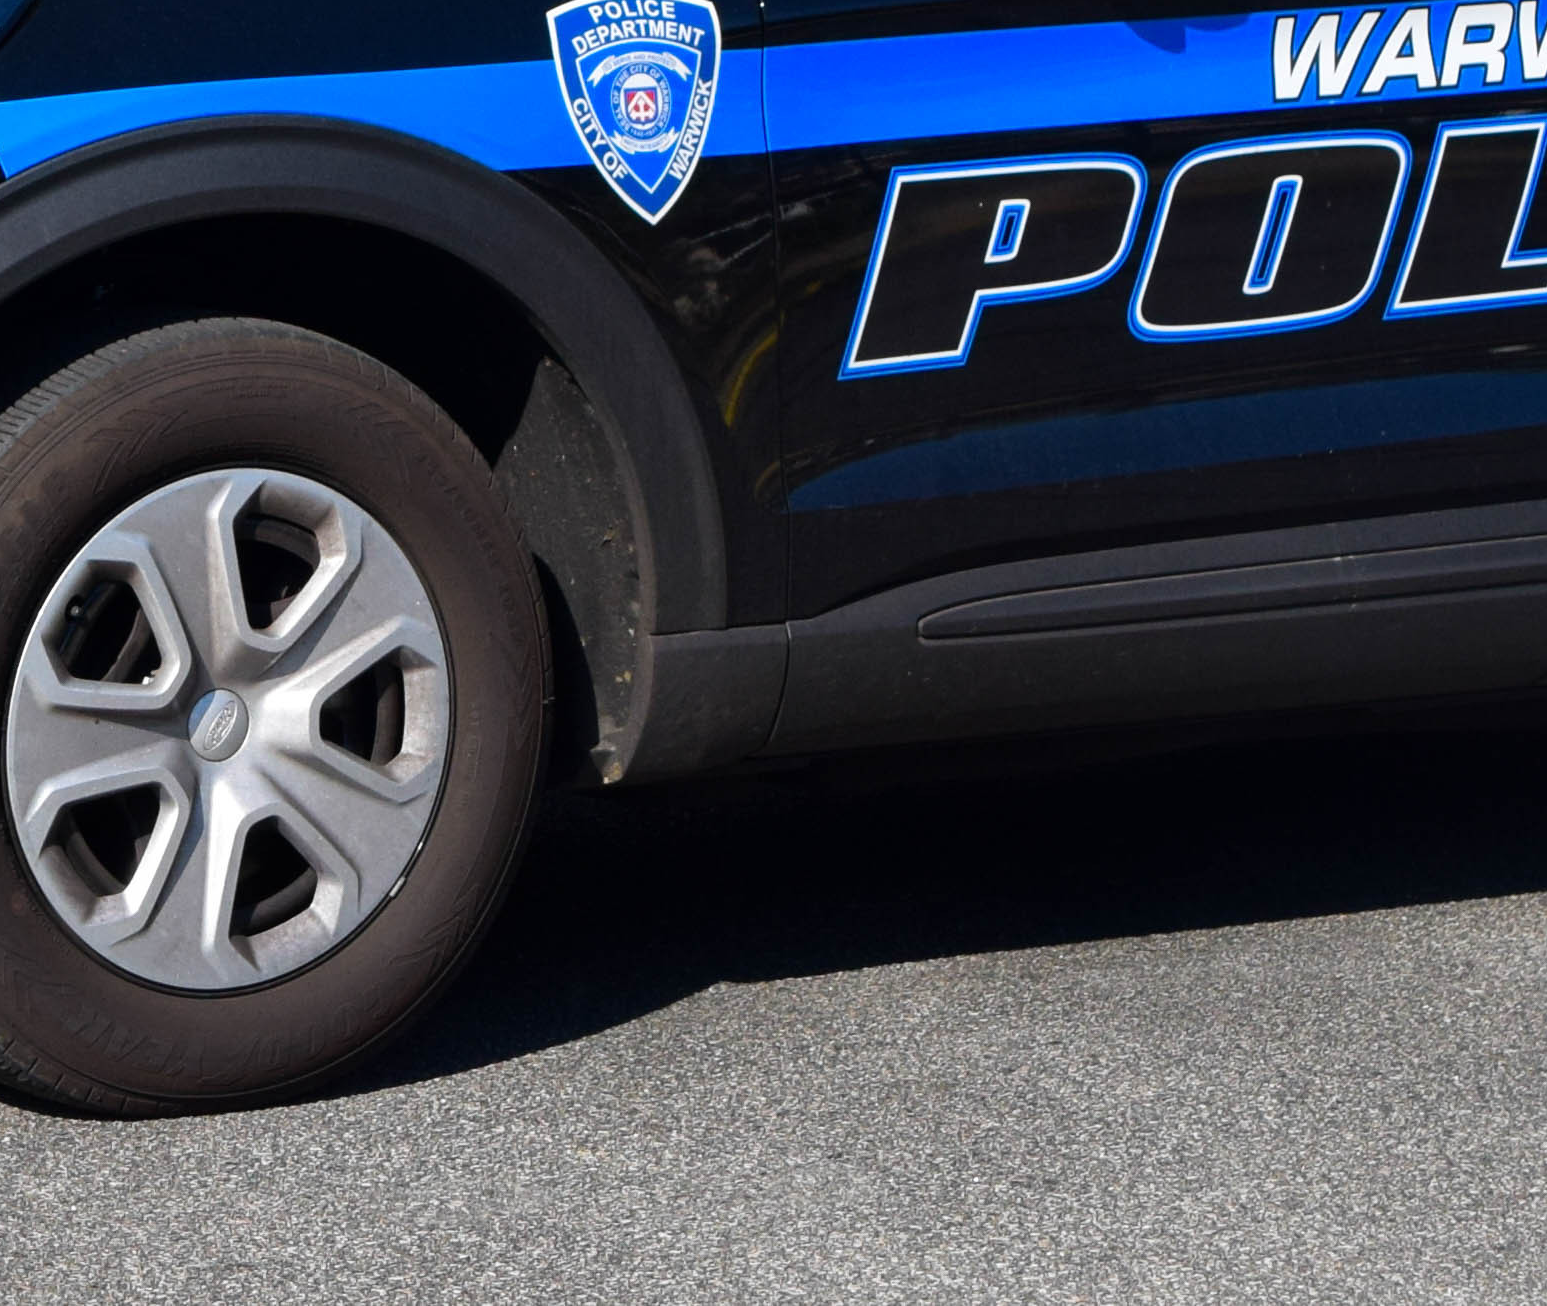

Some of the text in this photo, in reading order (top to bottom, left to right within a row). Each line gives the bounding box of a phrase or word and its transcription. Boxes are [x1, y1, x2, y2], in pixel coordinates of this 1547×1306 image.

[588, 0, 676, 24] POLICE
[571, 19, 705, 55] DEPARTMENT
[629, 65, 650, 74] CITY
[572, 79, 712, 180] CITY OF WARWICK
